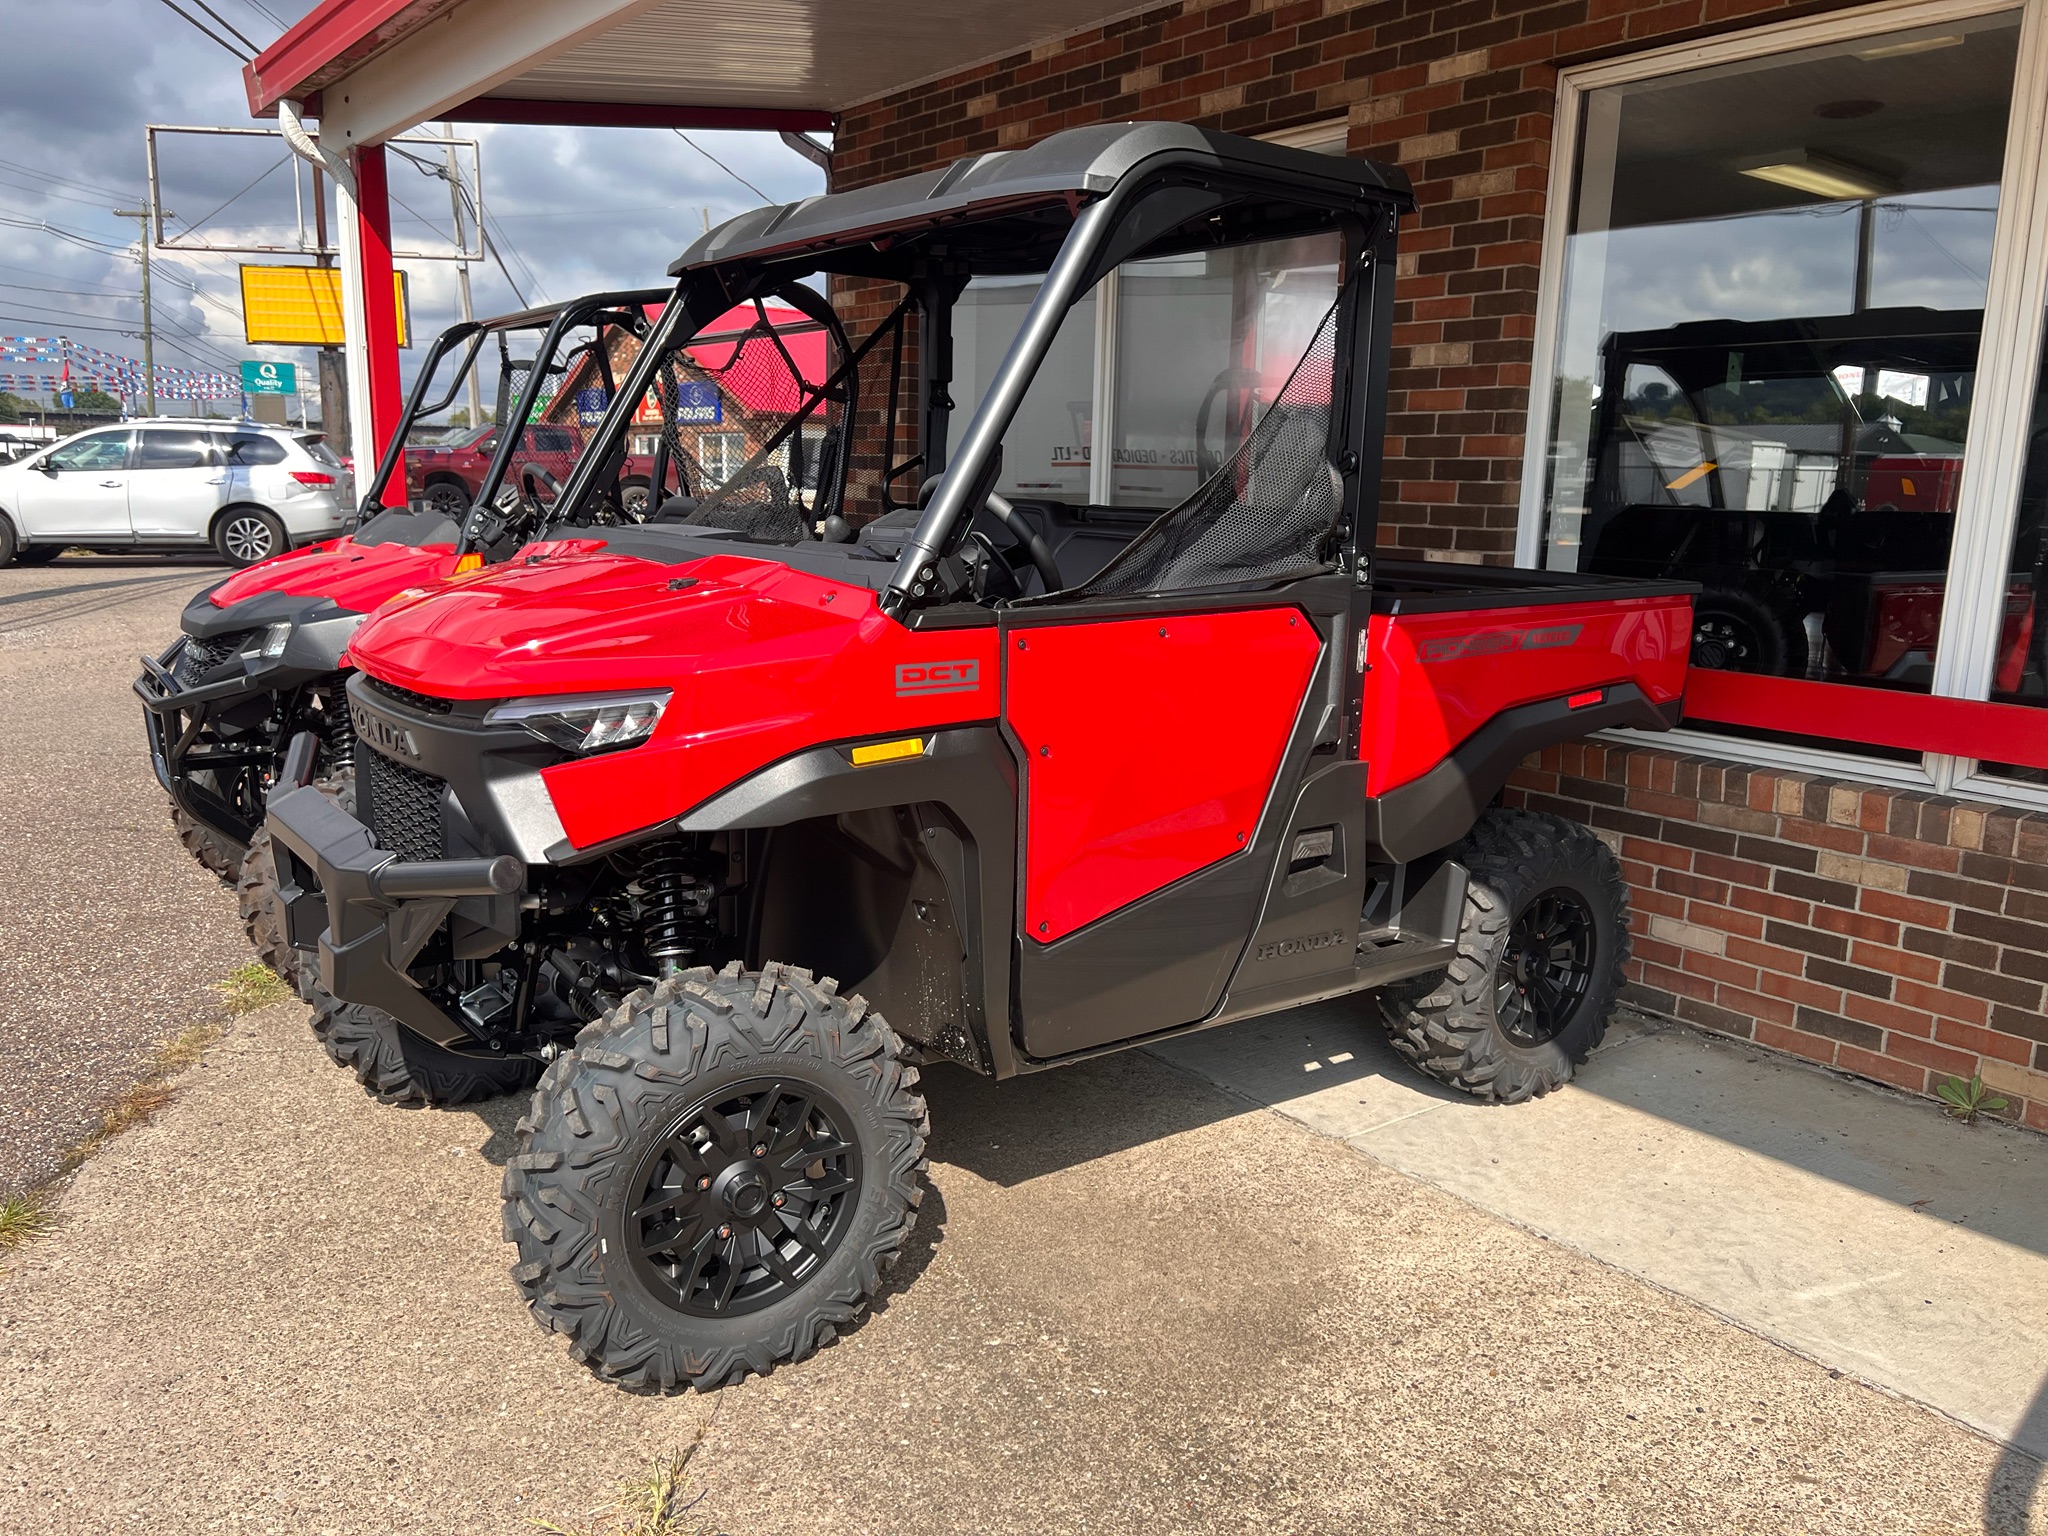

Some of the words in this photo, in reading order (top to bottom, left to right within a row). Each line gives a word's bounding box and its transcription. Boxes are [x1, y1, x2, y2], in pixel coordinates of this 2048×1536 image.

[254, 378, 283, 388] Quality
[677, 405, 716, 420] POLARIS
[1426, 632, 1513, 656] PIONEER
[1532, 630, 1571, 645] 1000
[902, 664, 974, 682] DCT
[351, 703, 421, 760] HONDA
[1256, 929, 1350, 962] HONDA
[861, 1102, 880, 1131] RADIAL
[606, 1092, 689, 1212] MAXXIS
[808, 1186, 885, 1300] BIGHORN
